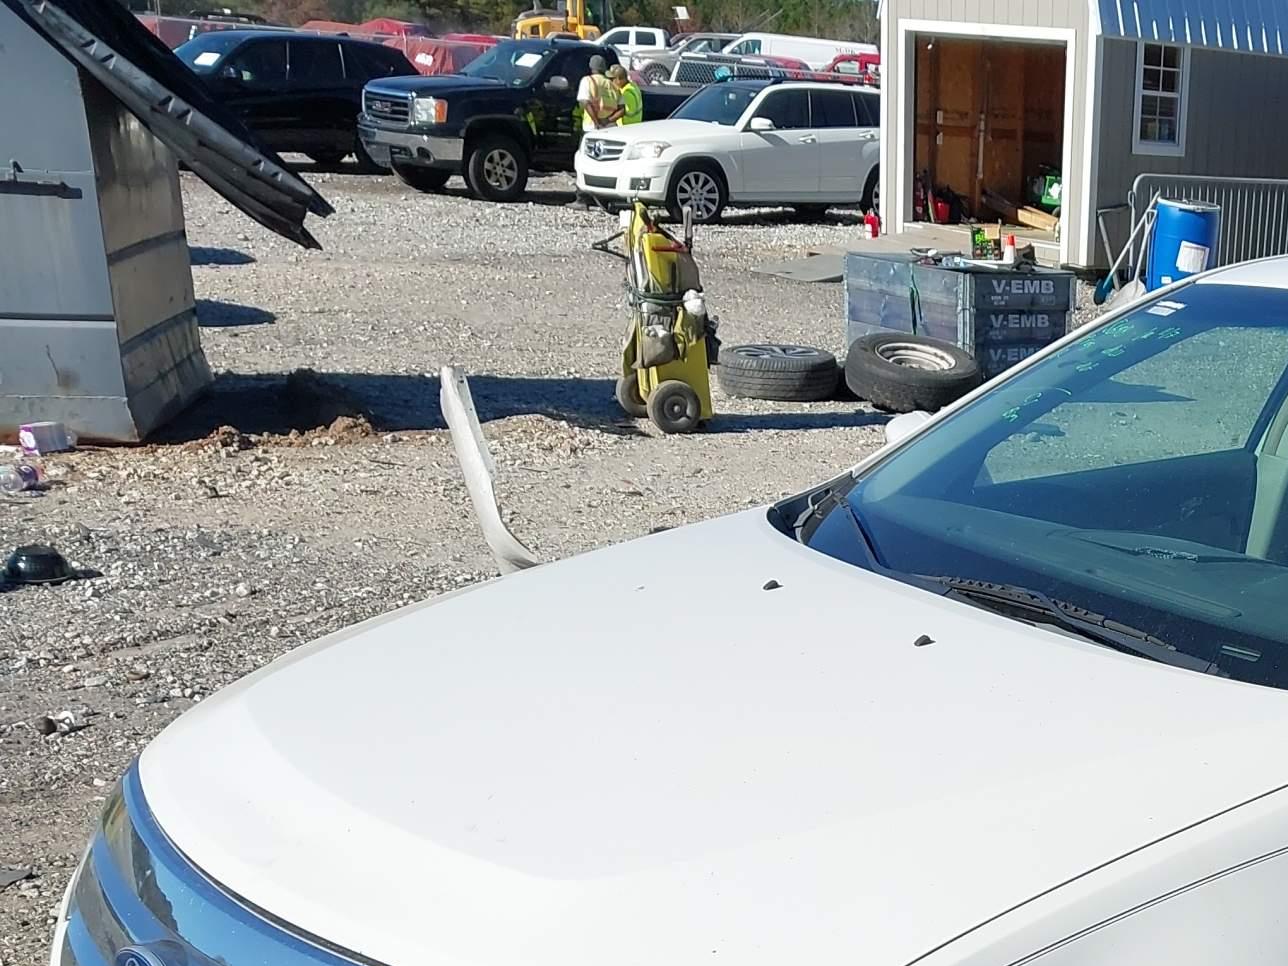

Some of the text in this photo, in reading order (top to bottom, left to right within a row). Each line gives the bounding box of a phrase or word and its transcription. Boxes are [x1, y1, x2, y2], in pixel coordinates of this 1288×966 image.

[991, 279, 1055, 294] V-EMB
[989, 314, 1050, 328] V-EMB
[988, 348, 1042, 361] V-EM
